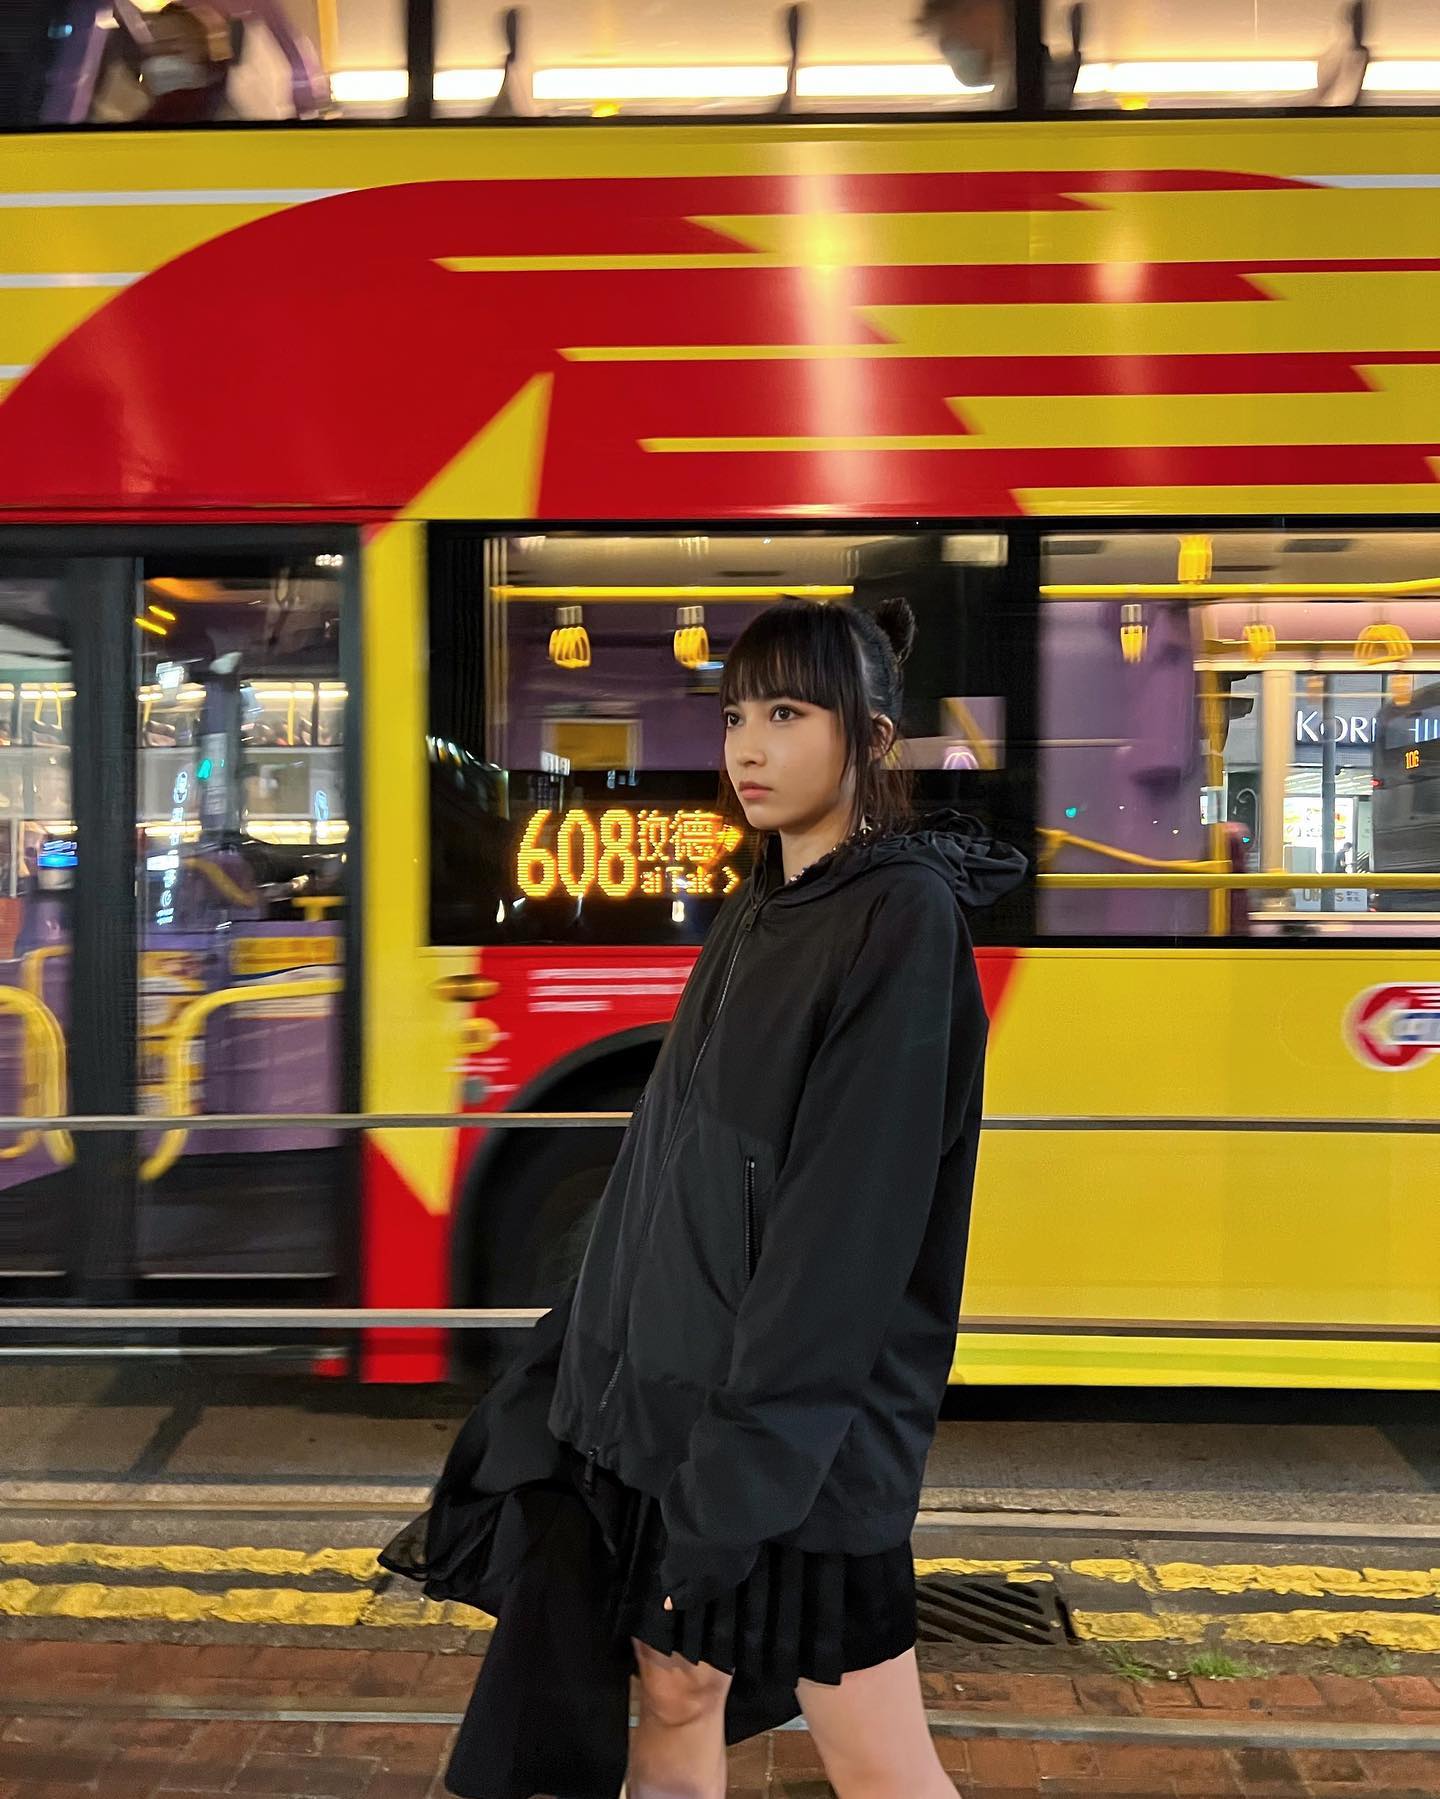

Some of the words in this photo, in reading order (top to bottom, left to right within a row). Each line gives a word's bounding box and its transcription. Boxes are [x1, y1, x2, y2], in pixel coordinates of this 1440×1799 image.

[1405, 749, 1420, 769] 106
[517, 809, 635, 897] 608
[665, 866, 713, 894] Tak
